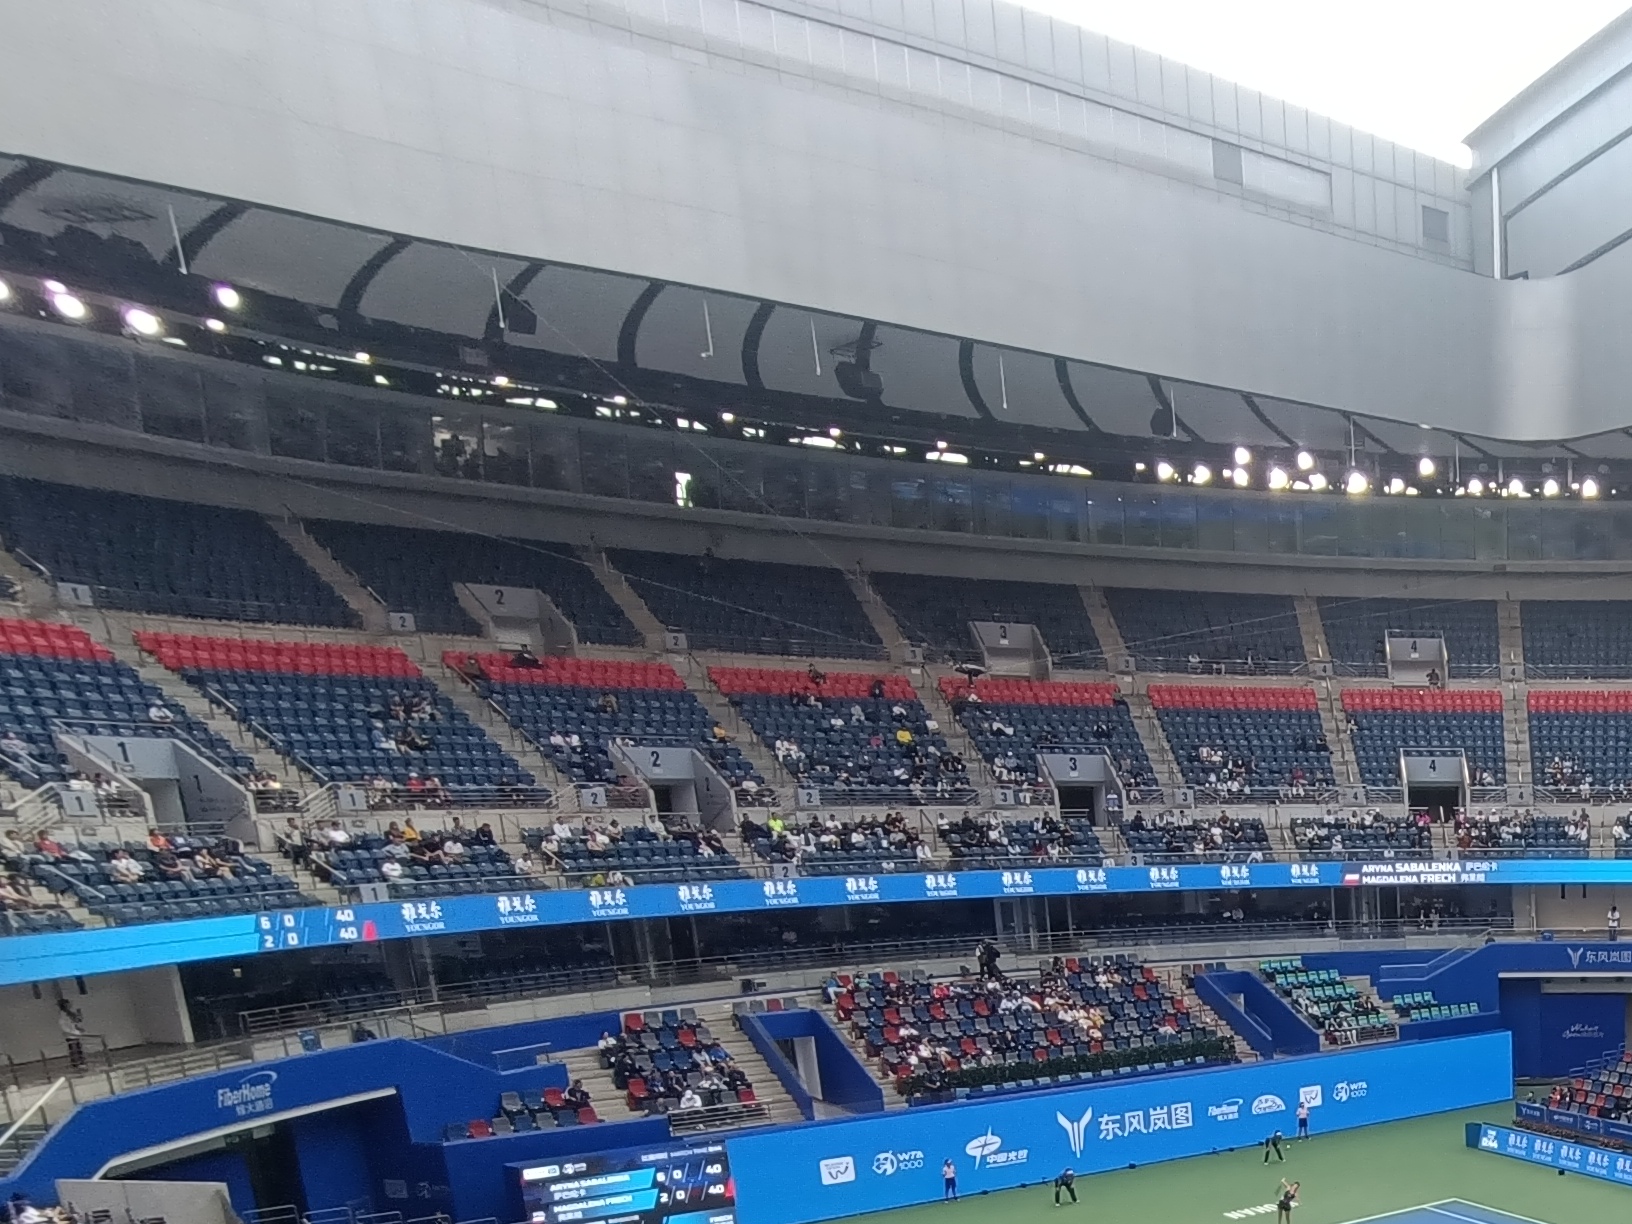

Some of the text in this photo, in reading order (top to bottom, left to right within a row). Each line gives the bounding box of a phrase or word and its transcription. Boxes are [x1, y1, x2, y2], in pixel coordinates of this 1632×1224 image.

[495, 590, 504, 605] 2
[399, 616, 406, 627] 2
[1000, 625, 1007, 639] 3
[1411, 641, 1417, 652] 4
[118, 742, 129, 762] 1
[651, 751, 660, 767] 2
[1069, 757, 1077, 771] 3
[1429, 760, 1436, 771] 4
[349, 793, 356, 806] 1
[591, 793, 598, 804] 2
[806, 792, 813, 803] 2
[1001, 792, 1007, 802] 3
[1182, 792, 1187, 802] 3
[1353, 792, 1358, 801] 4
[1519, 792, 1524, 800] 4
[75, 796, 84, 811] 1
[1446, 850, 1451, 860] 4
[1131, 856, 1137, 866] 3
[782, 866, 789, 877] 2
[1362, 863, 1461, 873] ARYNA SABALENKA
[1362, 875, 1419, 884] MAGDALENA
[1420, 873, 1456, 883] FRECH
[371, 888, 378, 901] 1
[260, 909, 354, 929] 6 0 40
[264, 927, 358, 948] 2 0 40
[1585, 950, 1632, 963] 东风岚图
[1350, 1082, 1368, 1090] WTA
[218, 1083, 271, 1108] FiberHome
[1351, 1088, 1368, 1098] 1000
[1098, 1101, 1193, 1140] 东风岚图
[897, 1151, 924, 1161] WTA
[899, 1159, 924, 1170] 1000
[656, 1164, 722, 1182] 6 0 40
[660, 1184, 725, 1202] 2 0 40
[1223, 1201, 1299, 1219] UHAN
